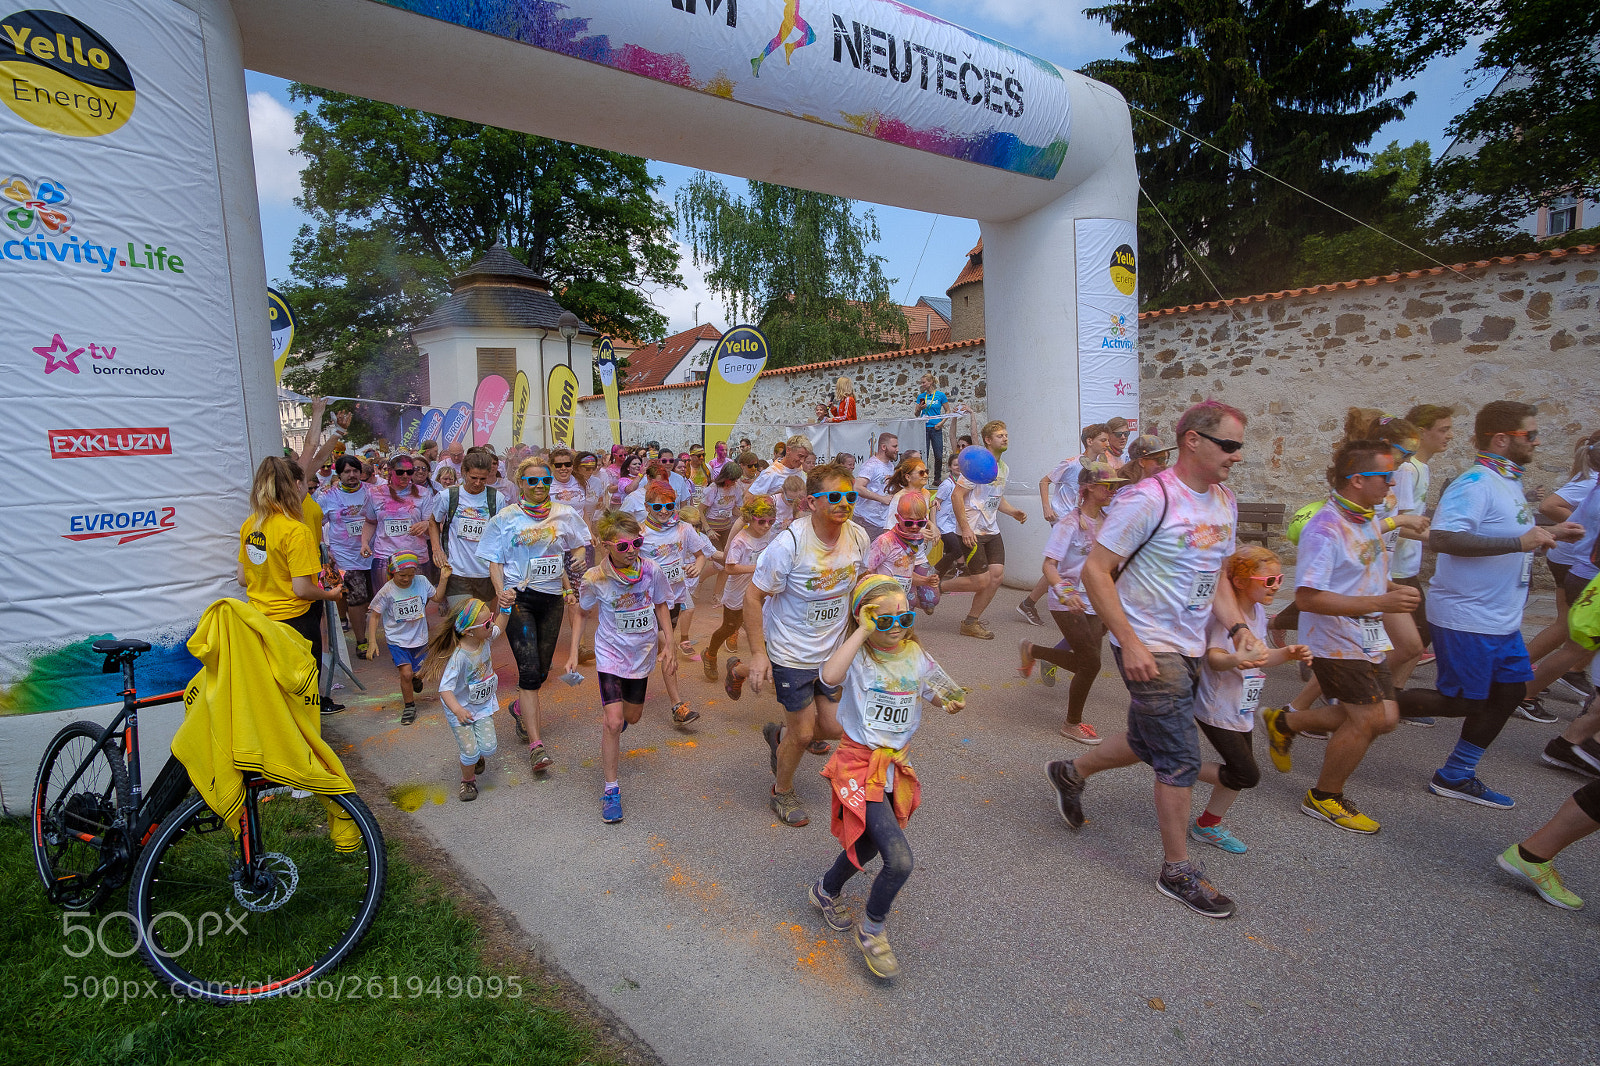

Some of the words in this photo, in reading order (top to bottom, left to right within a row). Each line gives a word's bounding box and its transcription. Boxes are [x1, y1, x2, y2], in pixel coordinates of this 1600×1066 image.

[2, 24, 110, 70] Yello
[832, 13, 1024, 119] NEUTEČEŠ
[12, 79, 118, 120] Energy
[1116, 251, 1135, 266] Yello
[88, 342, 117, 360] tv
[724, 341, 759, 354] Yello
[92, 364, 165, 376] barrandov
[724, 361, 758, 374] Energy
[553, 379, 574, 443] Nikon
[446, 412, 466, 443] EVROPA
[52, 433, 168, 453] EXKLUZIV
[70, 510, 158, 532] EVROPA
[159, 506, 176, 527] 2
[390, 524, 408, 533] 9319
[462, 524, 483, 534] 8340
[537, 564, 557, 574] 7912
[664, 567, 680, 579] 739
[398, 604, 419, 616] 8342
[814, 607, 839, 621] 7902
[622, 616, 649, 628] 7738
[874, 704, 909, 724] 7900
